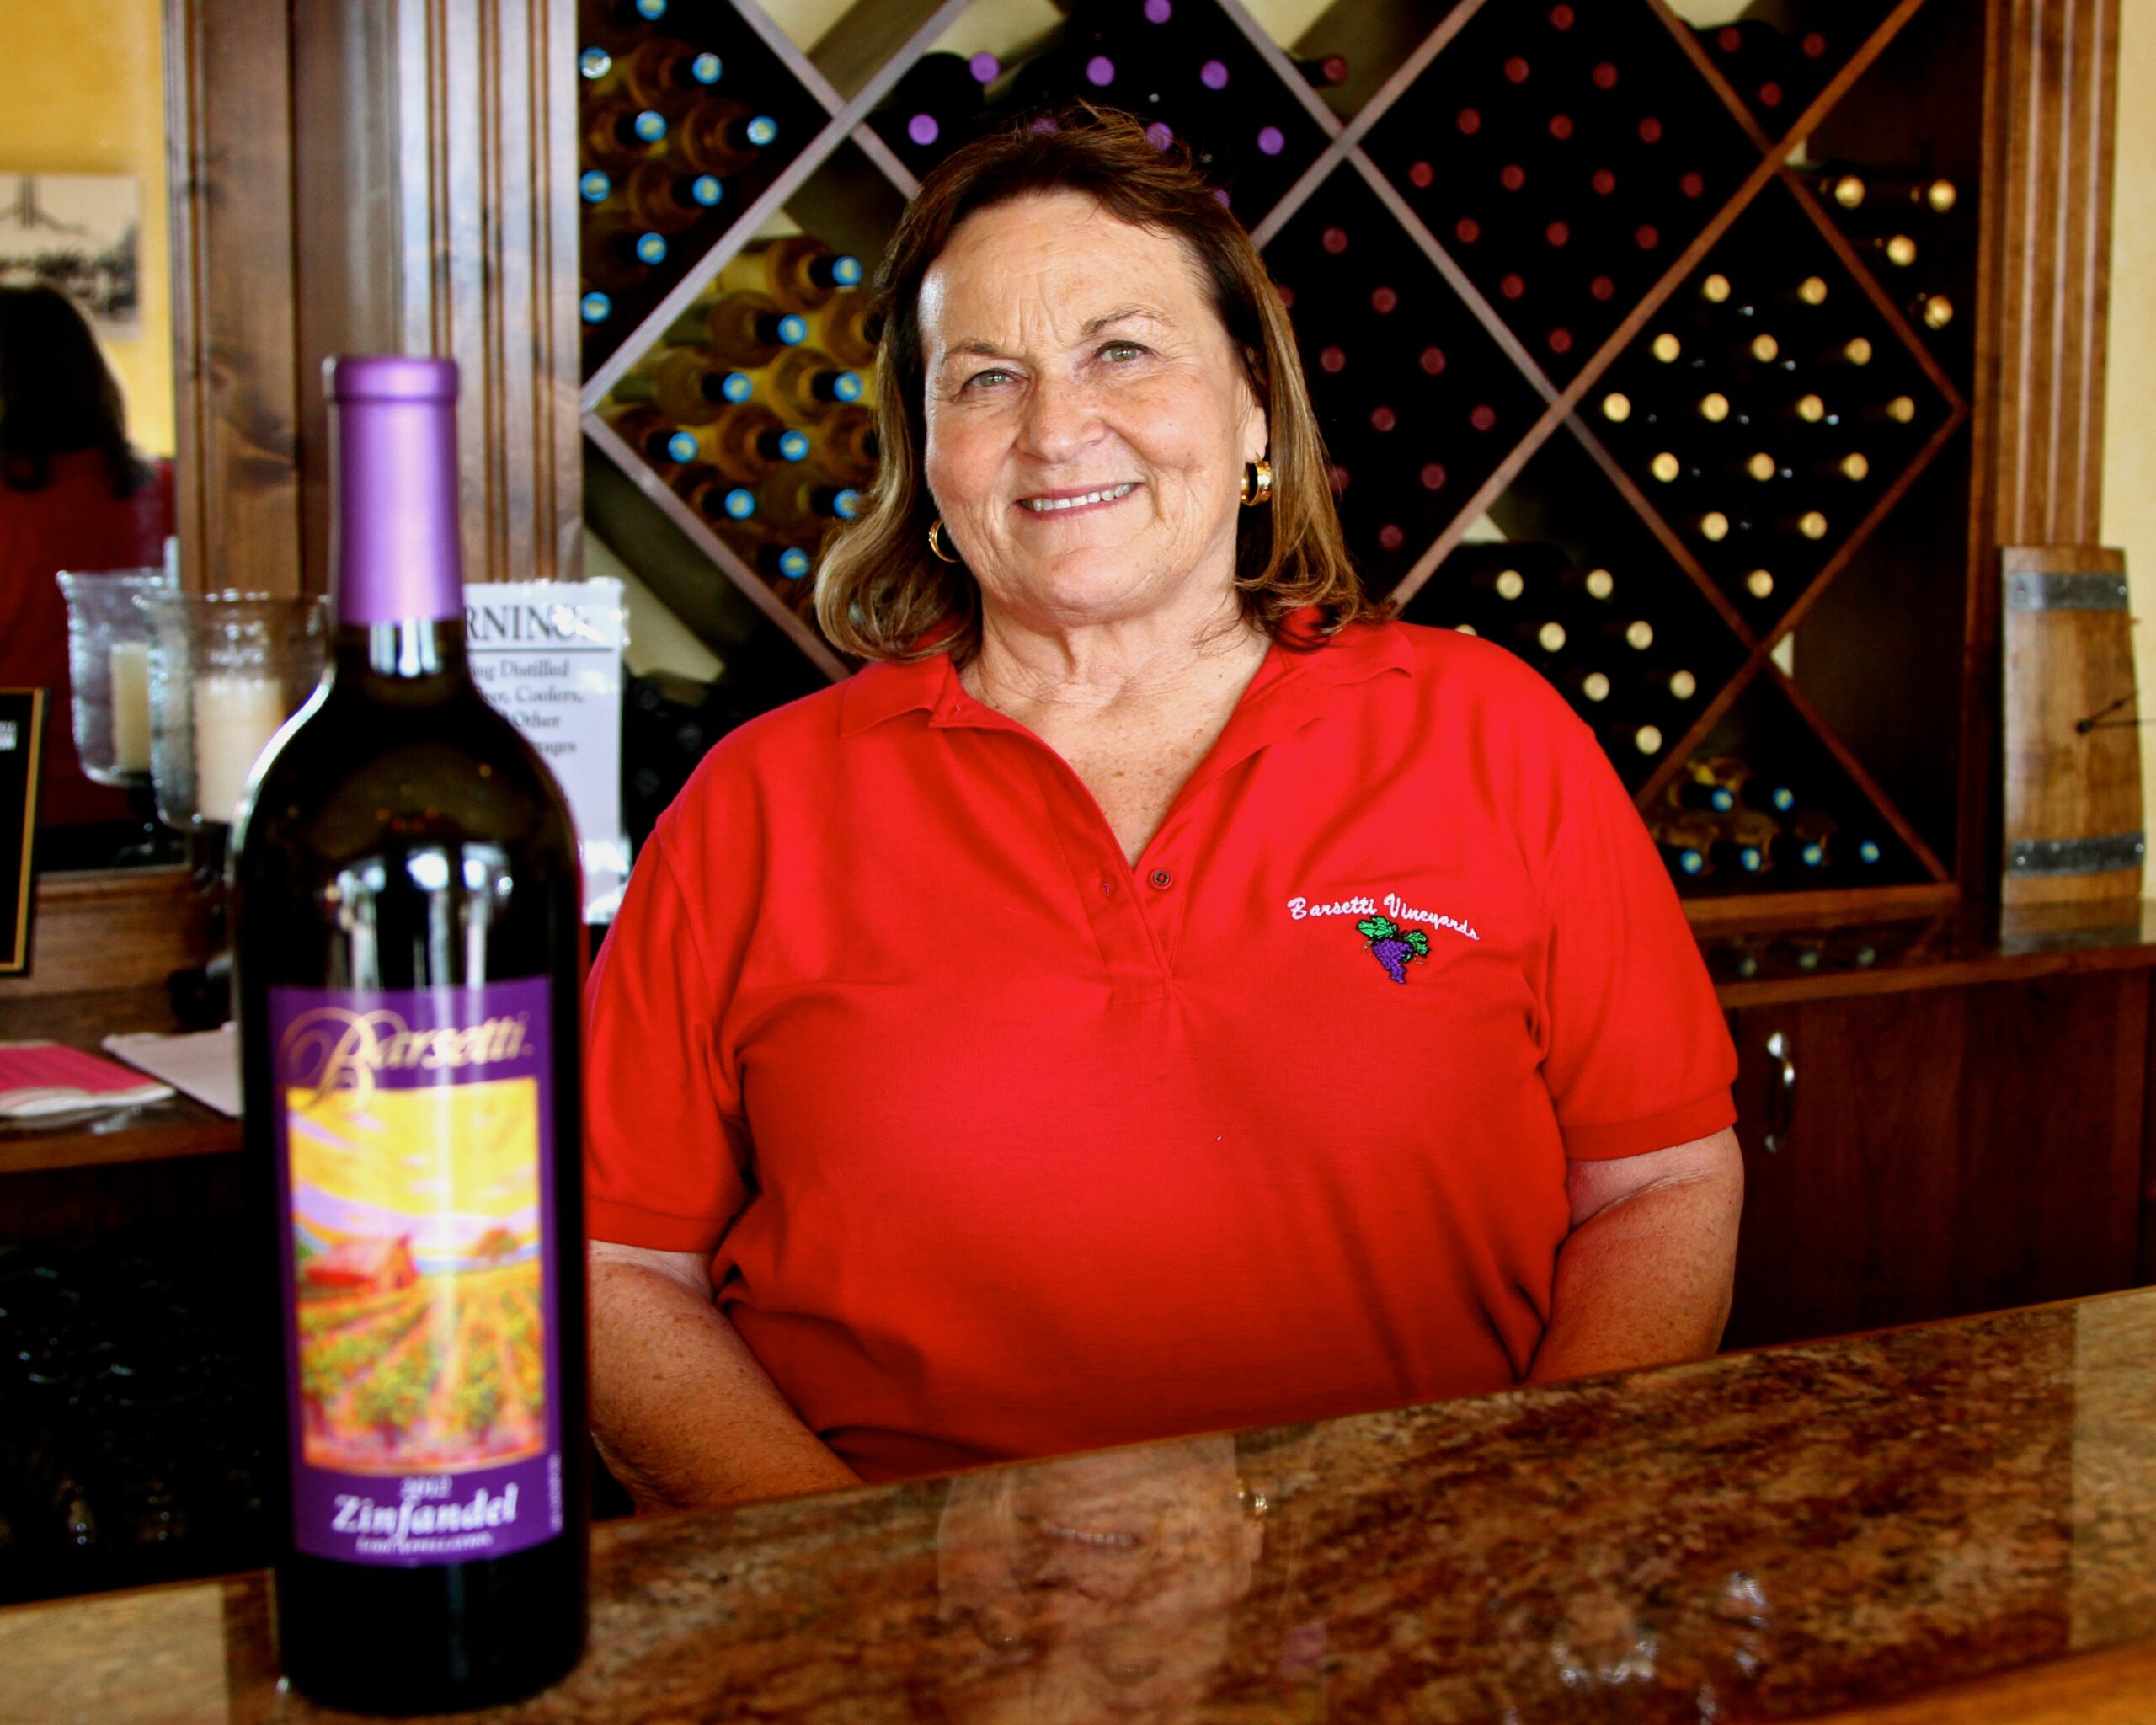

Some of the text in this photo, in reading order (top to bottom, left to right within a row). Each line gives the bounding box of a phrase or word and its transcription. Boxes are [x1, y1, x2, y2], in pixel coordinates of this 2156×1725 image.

[500, 657, 571, 677] Distilled
[1287, 892, 1480, 941] Barsetti Vineyards
[279, 1007, 528, 1114] Barsetti
[331, 1482, 520, 1550] Zinfandel
